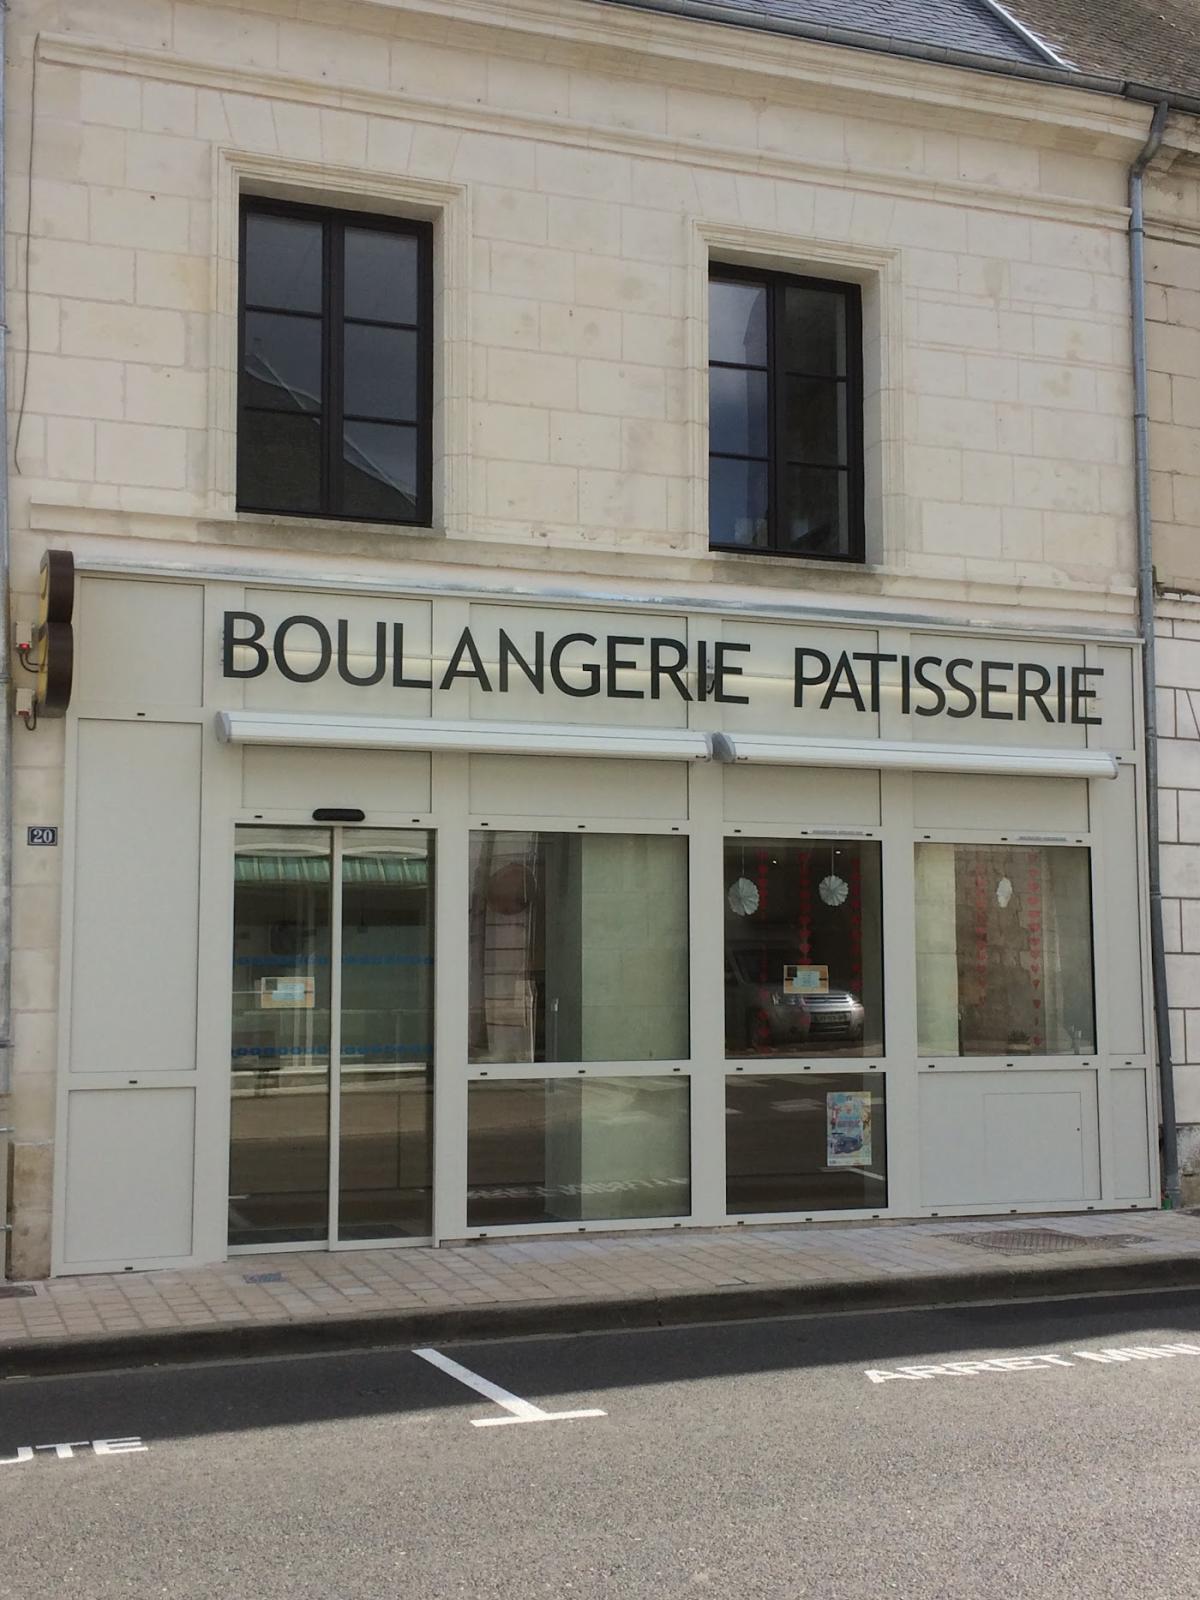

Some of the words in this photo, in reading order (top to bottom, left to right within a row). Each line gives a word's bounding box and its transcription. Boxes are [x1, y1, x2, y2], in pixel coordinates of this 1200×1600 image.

[223, 610, 751, 705] BOULANGERIE
[793, 647, 1104, 725] PATISSERIE
[32, 828, 54, 843] 20
[864, 1353, 1076, 1384] ARRET
